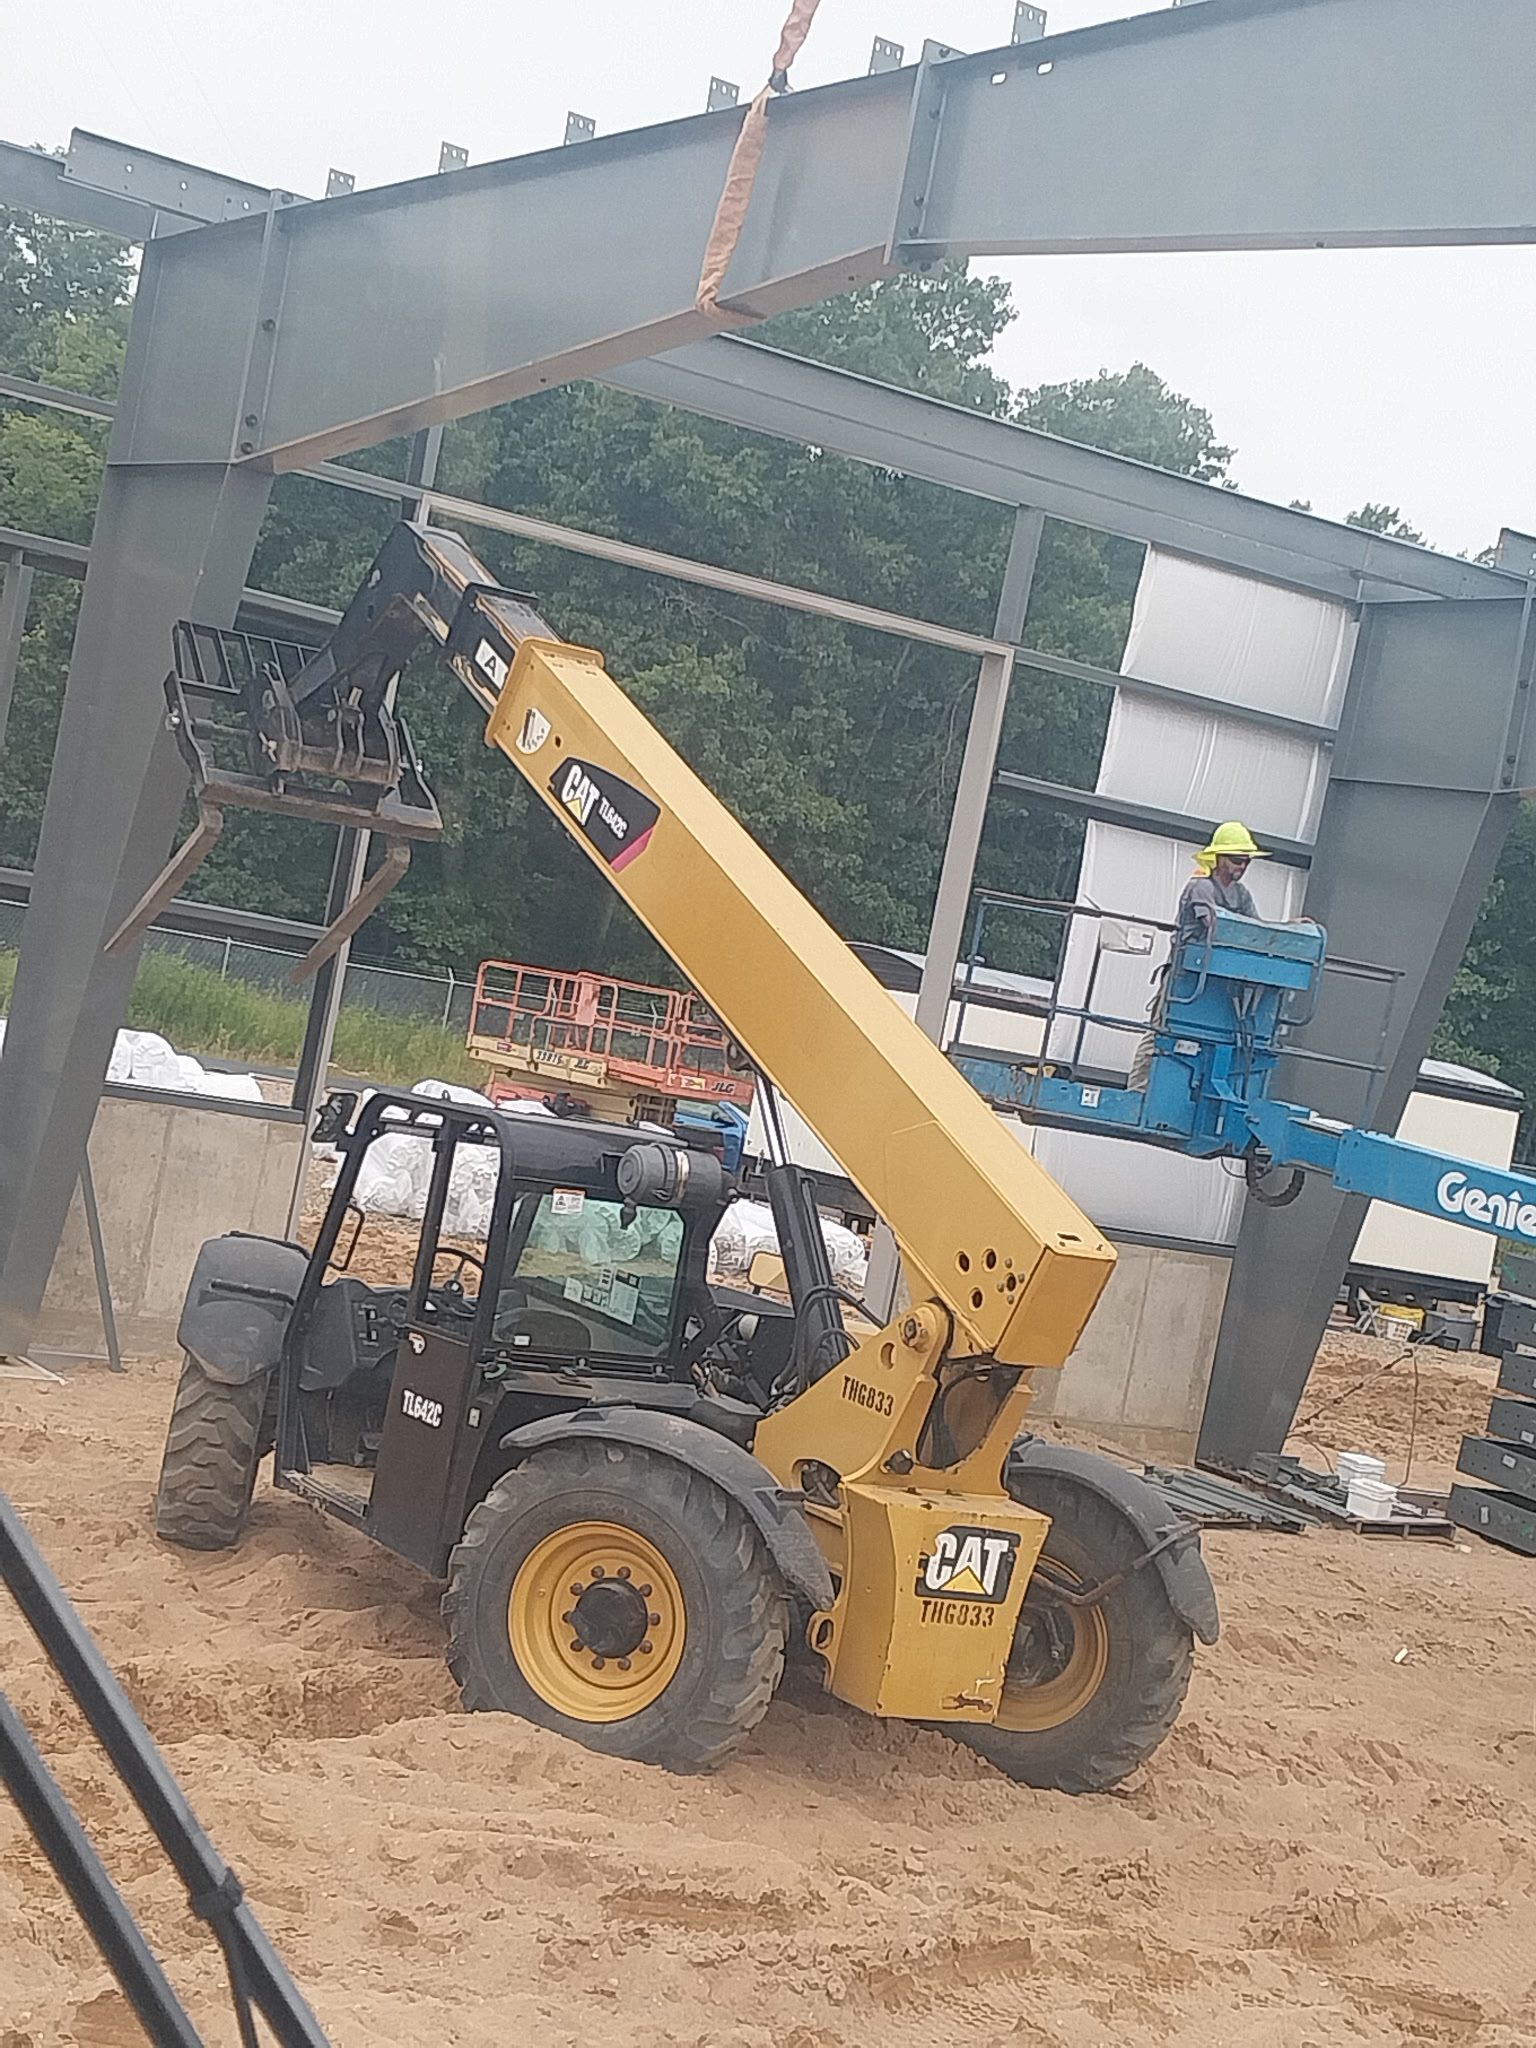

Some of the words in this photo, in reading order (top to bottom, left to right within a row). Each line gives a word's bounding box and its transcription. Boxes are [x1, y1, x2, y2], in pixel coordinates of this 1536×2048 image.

[484, 655, 497, 678] A
[561, 764, 600, 826] CAT
[599, 796, 627, 839] TL642C
[711, 1082, 735, 1094] JLG
[1437, 1171, 1536, 1237] Genie
[403, 1389, 442, 1427] TL642C
[924, 1532, 1009, 1596] CAT
